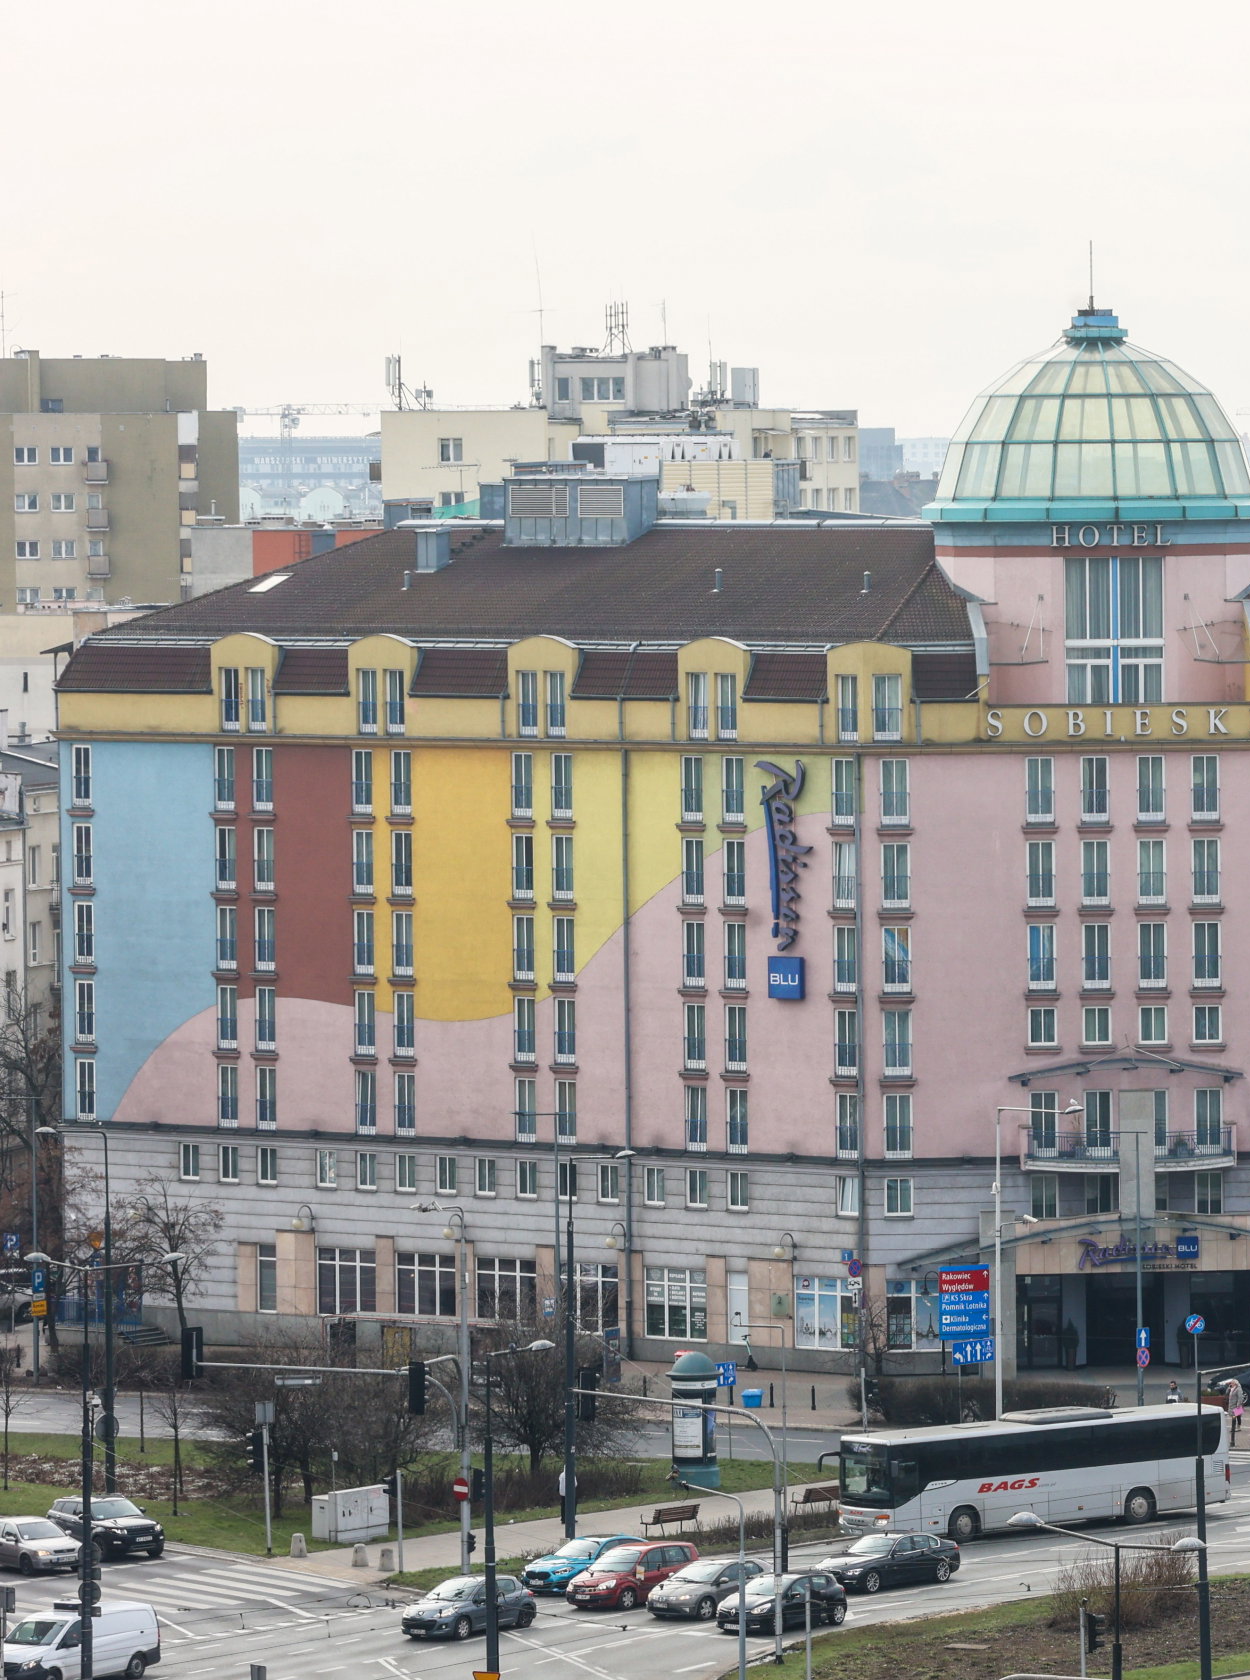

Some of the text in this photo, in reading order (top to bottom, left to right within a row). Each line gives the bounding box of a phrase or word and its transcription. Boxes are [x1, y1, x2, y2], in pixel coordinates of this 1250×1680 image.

[1050, 524, 1172, 548] HOTEL
[753, 759, 814, 951] Radisson
[770, 973, 799, 985] BLU
[1177, 1244, 1198, 1252] BLU
[35, 1272, 42, 1287] P
[942, 1283, 974, 1292] Wyględów
[960, 1293, 973, 1301] Skra
[942, 1302, 987, 1311] Pomnik Lotnika
[950, 1314, 969, 1322] Klinika
[942, 1323, 987, 1333] Dermatologiczna
[977, 1477, 1041, 1493] BAGS
